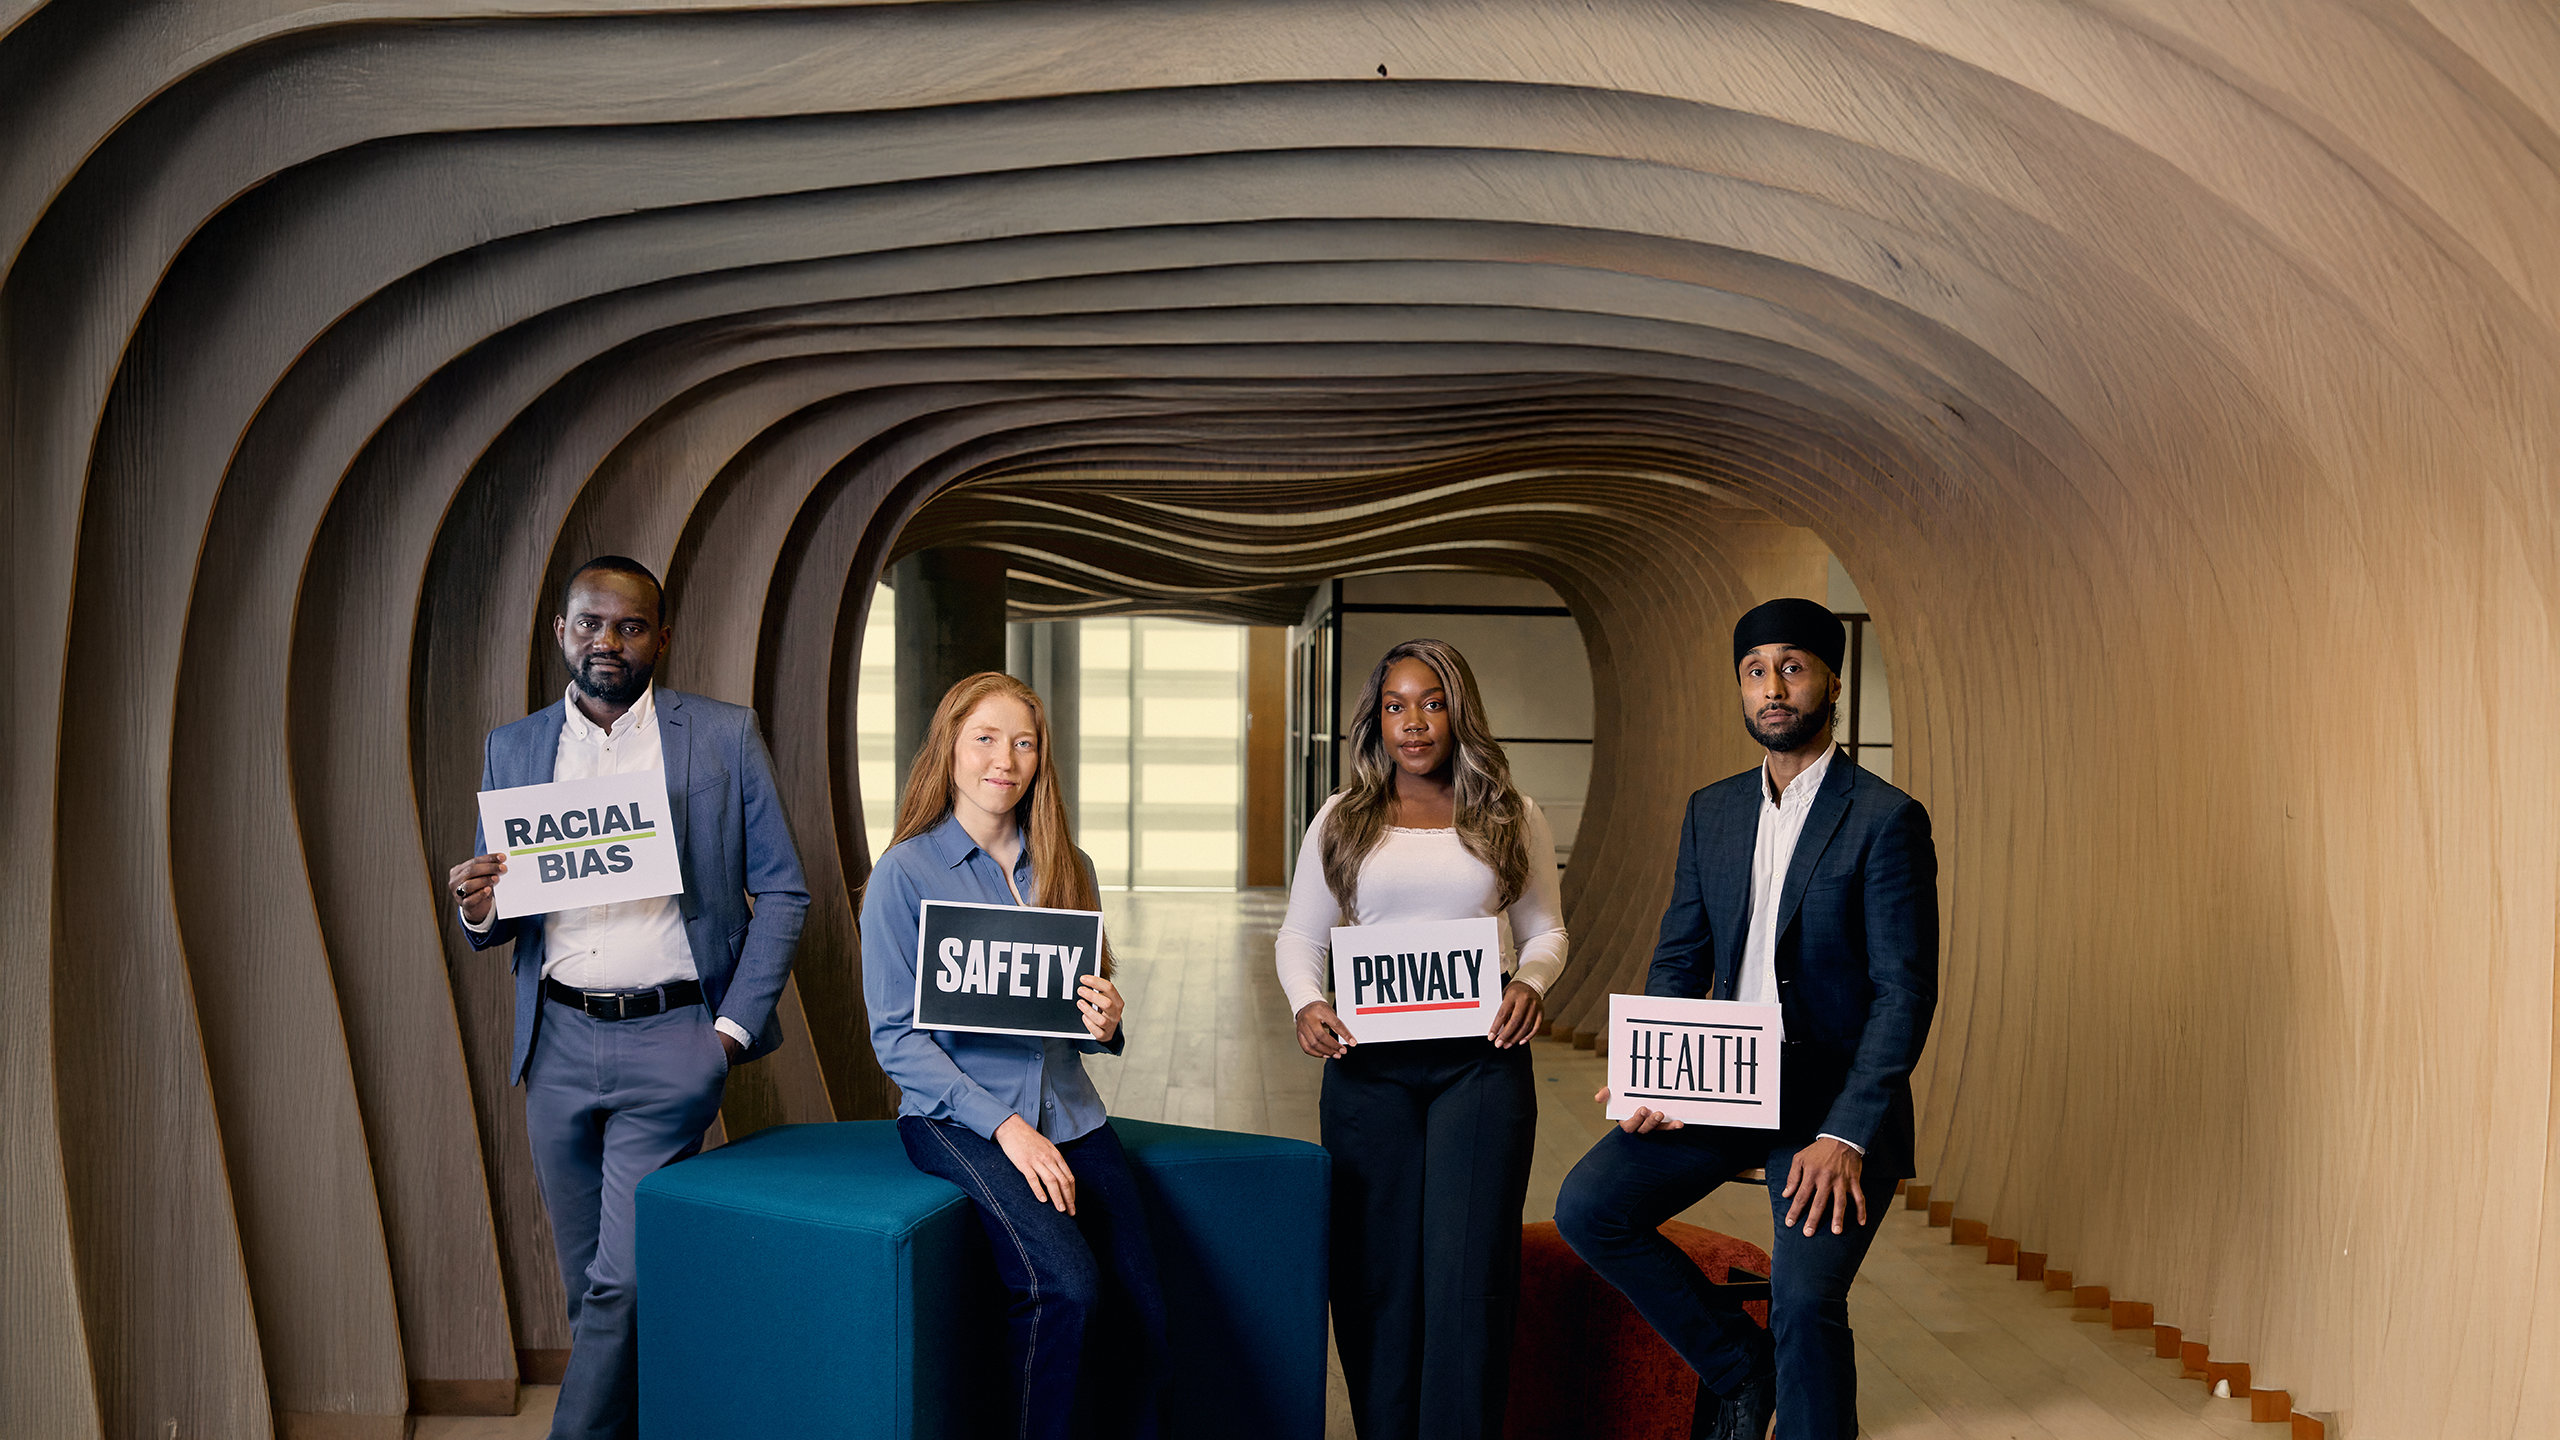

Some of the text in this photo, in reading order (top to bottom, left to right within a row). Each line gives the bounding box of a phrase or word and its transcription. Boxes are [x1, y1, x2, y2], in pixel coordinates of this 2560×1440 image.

[504, 802, 655, 847] RACIAL
[537, 844, 634, 883] BIAS
[936, 937, 1084, 1000] SAFETY
[1352, 949, 1483, 1005] PRIVACY
[1630, 1029, 1759, 1095] HEALTH
